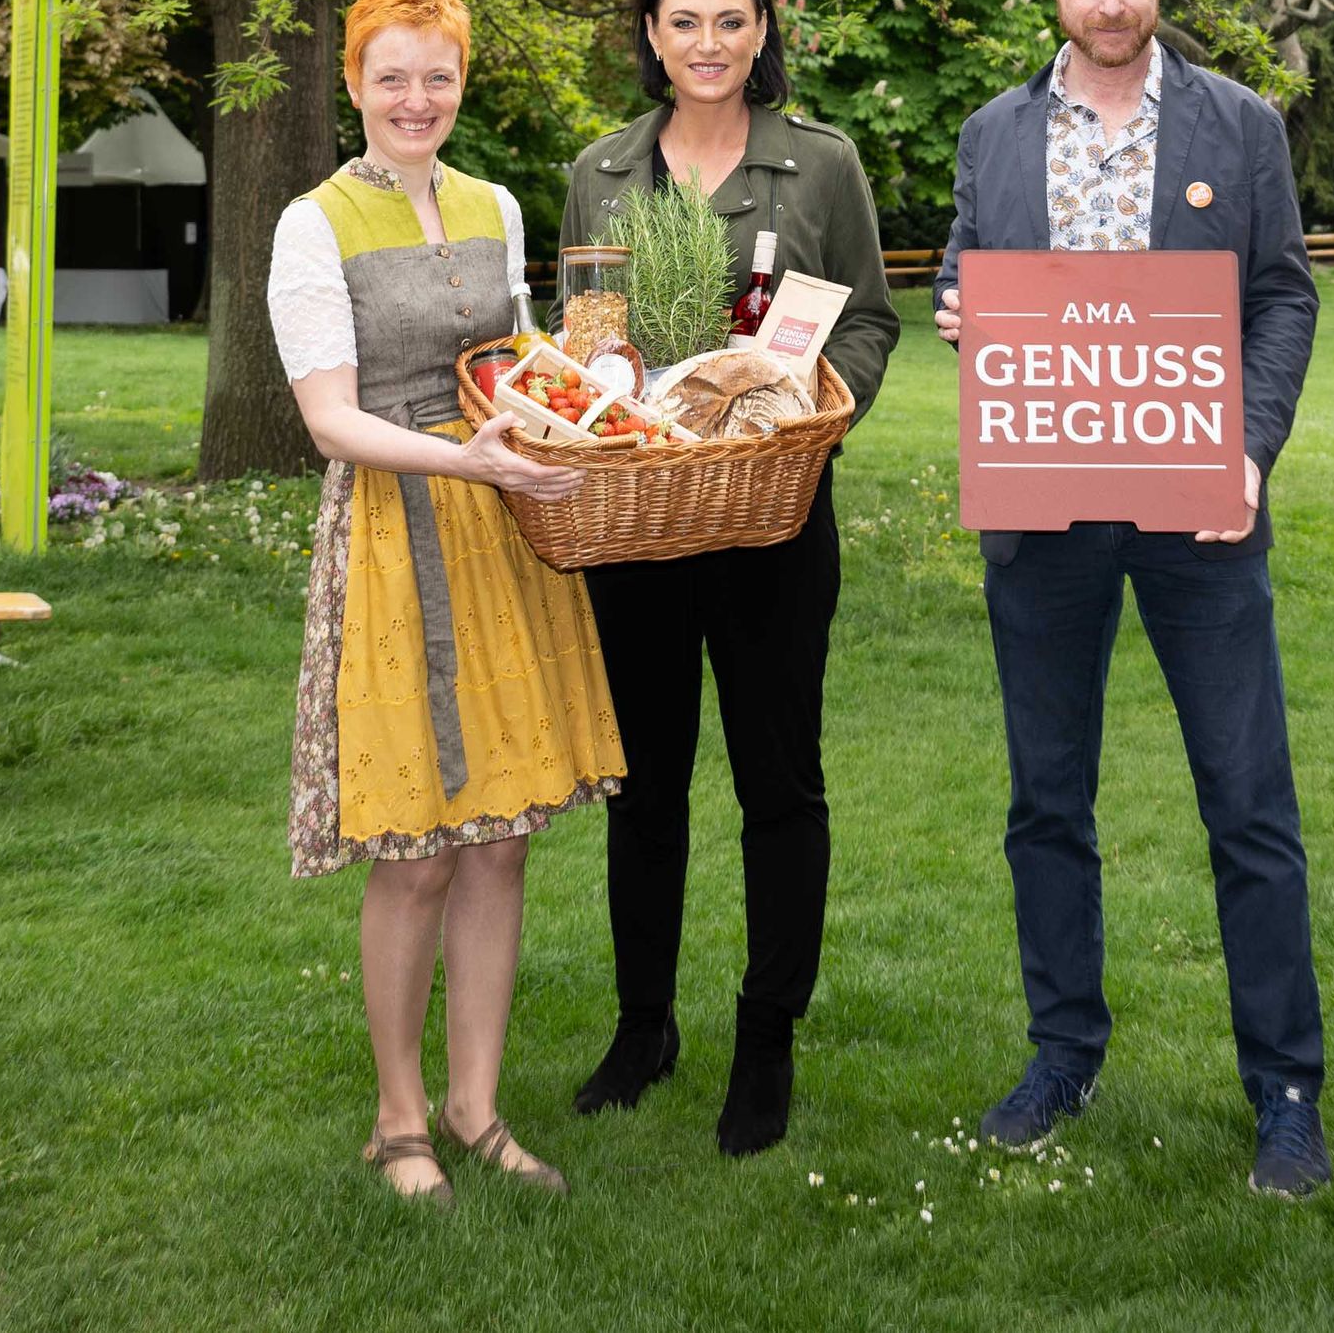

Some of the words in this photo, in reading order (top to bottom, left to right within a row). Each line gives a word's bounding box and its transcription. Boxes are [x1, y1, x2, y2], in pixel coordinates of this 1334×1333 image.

[1061, 302, 1136, 325] AMA
[773, 334, 809, 347] REGION
[777, 327, 812, 341] GENUSS
[974, 343, 1226, 388] GENUSS
[978, 400, 1224, 445] REGION
